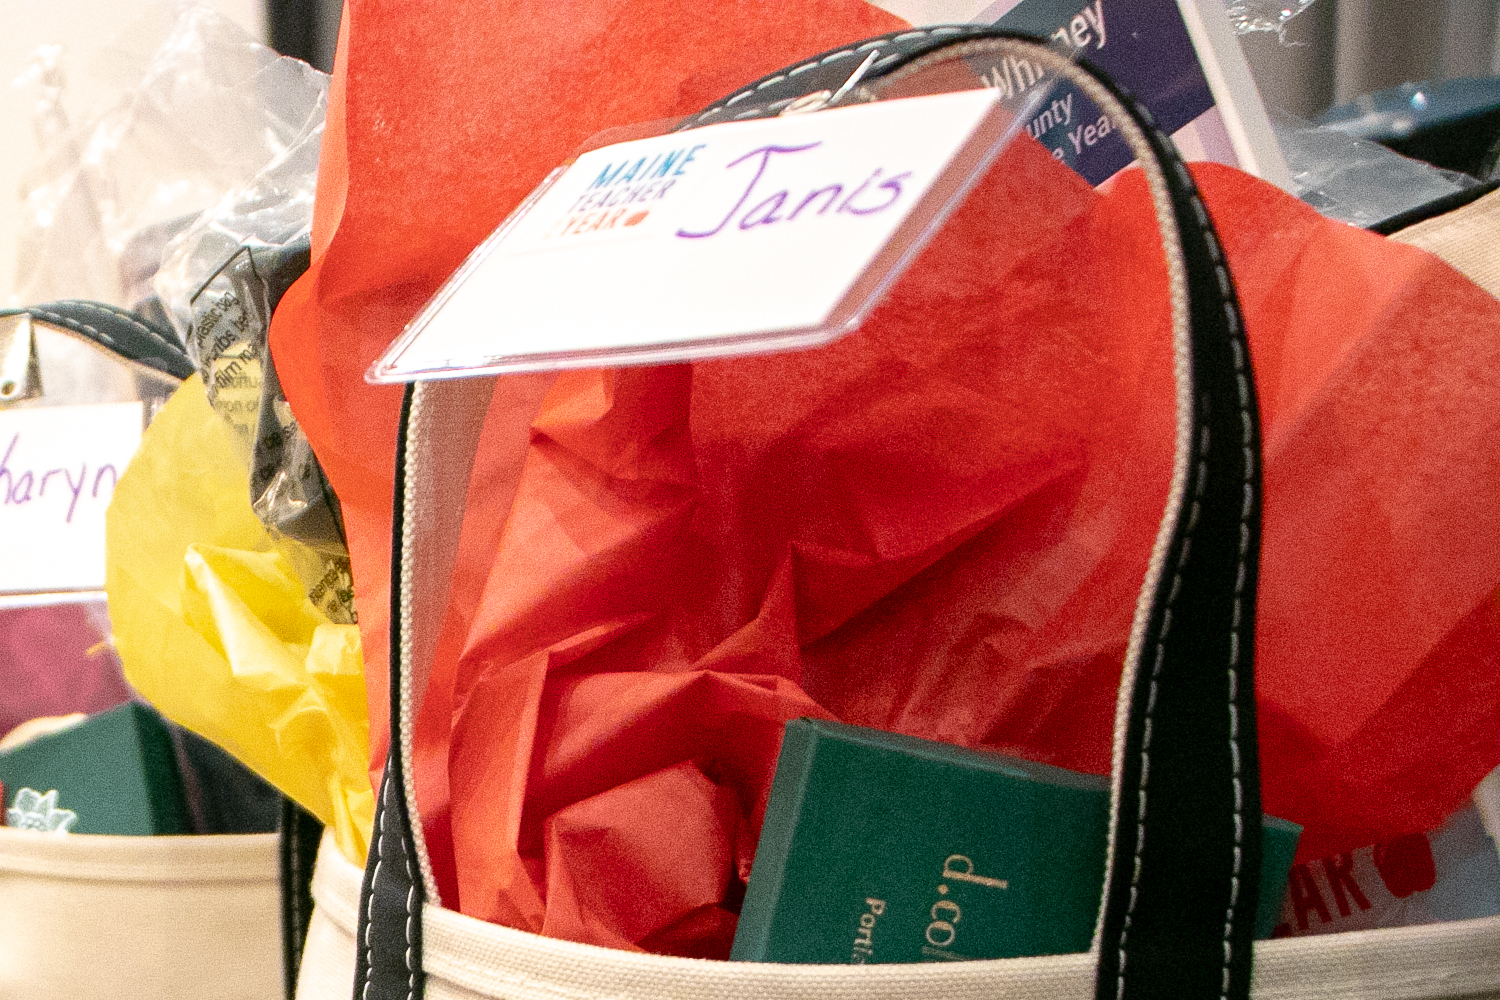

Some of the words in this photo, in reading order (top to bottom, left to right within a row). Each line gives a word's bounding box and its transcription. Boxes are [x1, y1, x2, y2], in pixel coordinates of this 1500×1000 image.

[1068, 114, 1116, 155] Yea
[590, 143, 706, 190] MAINE
[567, 179, 676, 214] TEACHER
[674, 140, 912, 238] Janis
[559, 208, 628, 237] YEAR
